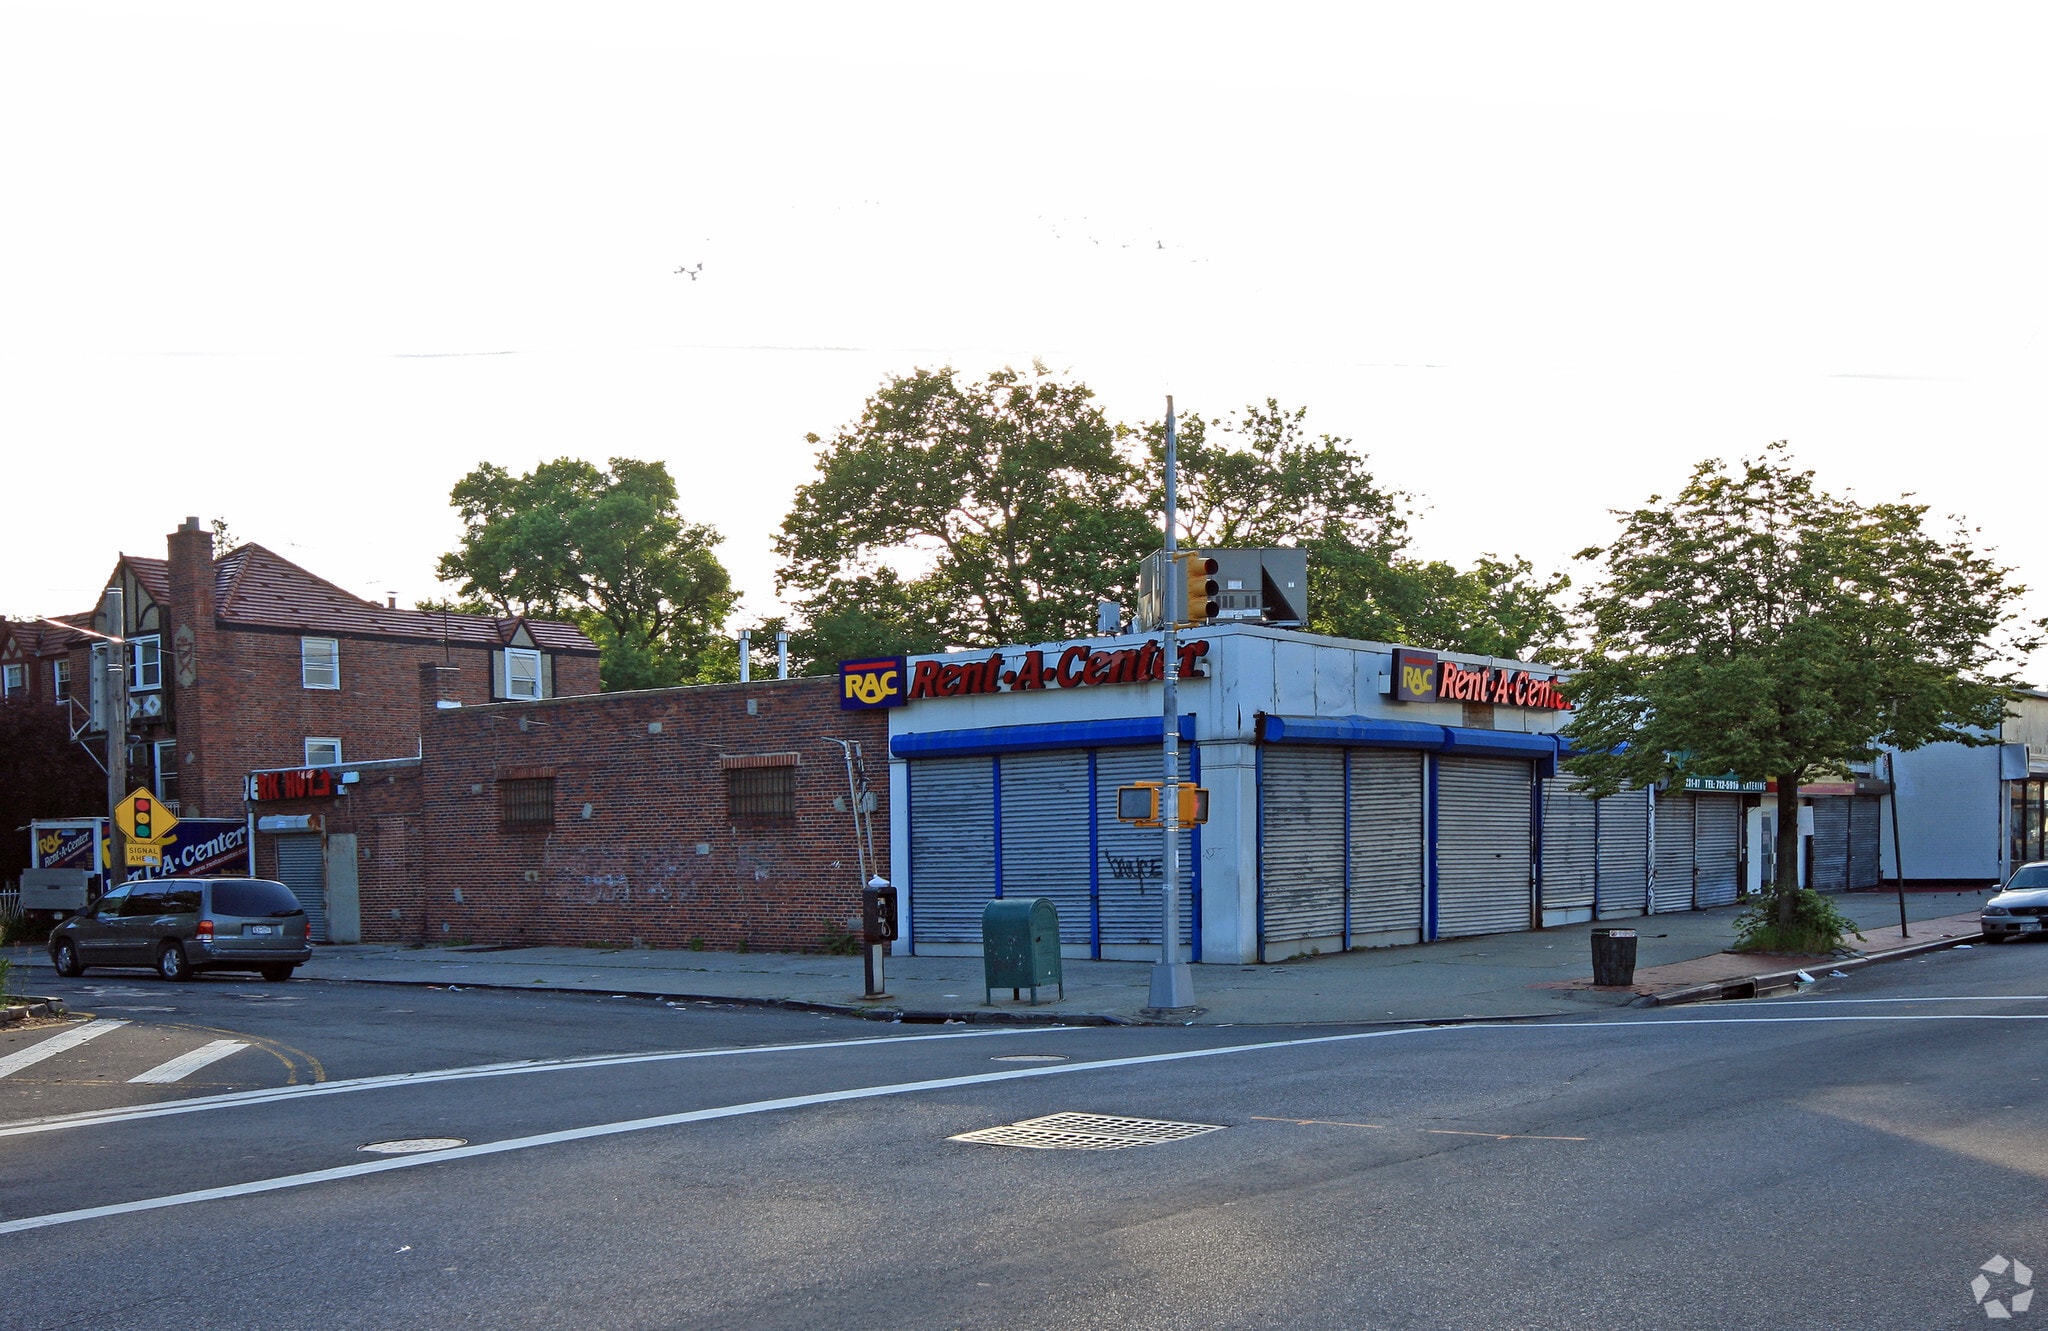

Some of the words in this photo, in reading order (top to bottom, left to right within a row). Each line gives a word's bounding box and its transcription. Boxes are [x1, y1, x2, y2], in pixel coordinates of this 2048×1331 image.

[845, 671, 898, 704] RAC
[1402, 665, 1433, 696] RAC
[285, 769, 316, 798] HUT
[39, 829, 64, 855] RAC
[129, 847, 158, 855] SIGNAL
